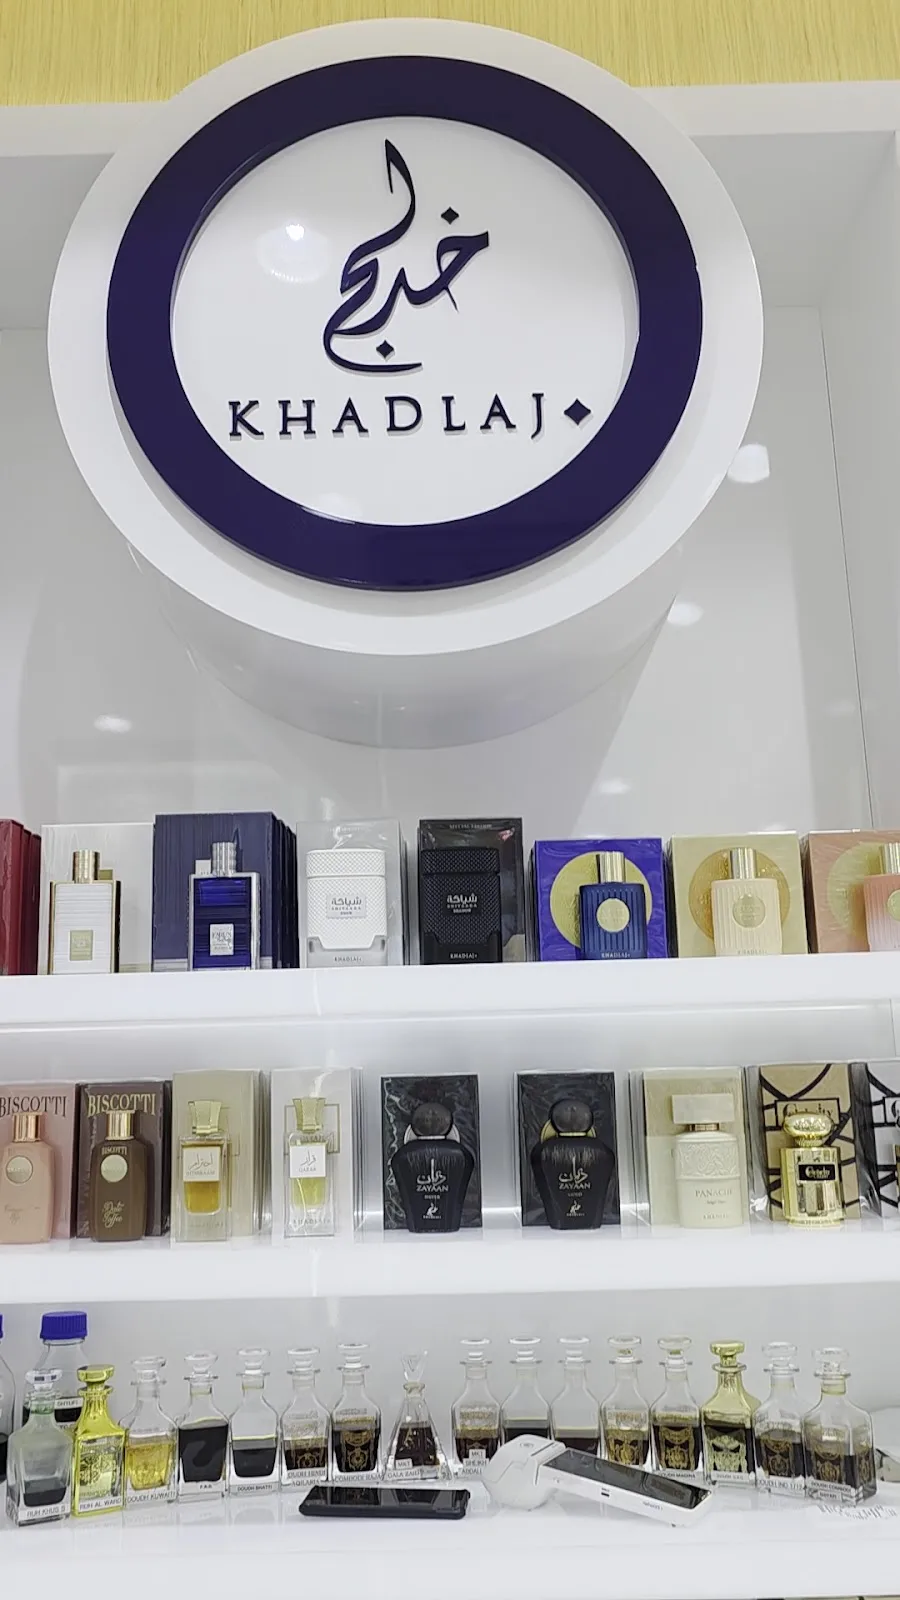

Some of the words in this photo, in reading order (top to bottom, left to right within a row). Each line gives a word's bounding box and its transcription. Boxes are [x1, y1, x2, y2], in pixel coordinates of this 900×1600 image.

[227, 393, 545, 440] KHADLAJ
[0, 1096, 67, 1118] BISCOTTI
[87, 1093, 156, 1117] BISCOTTI
